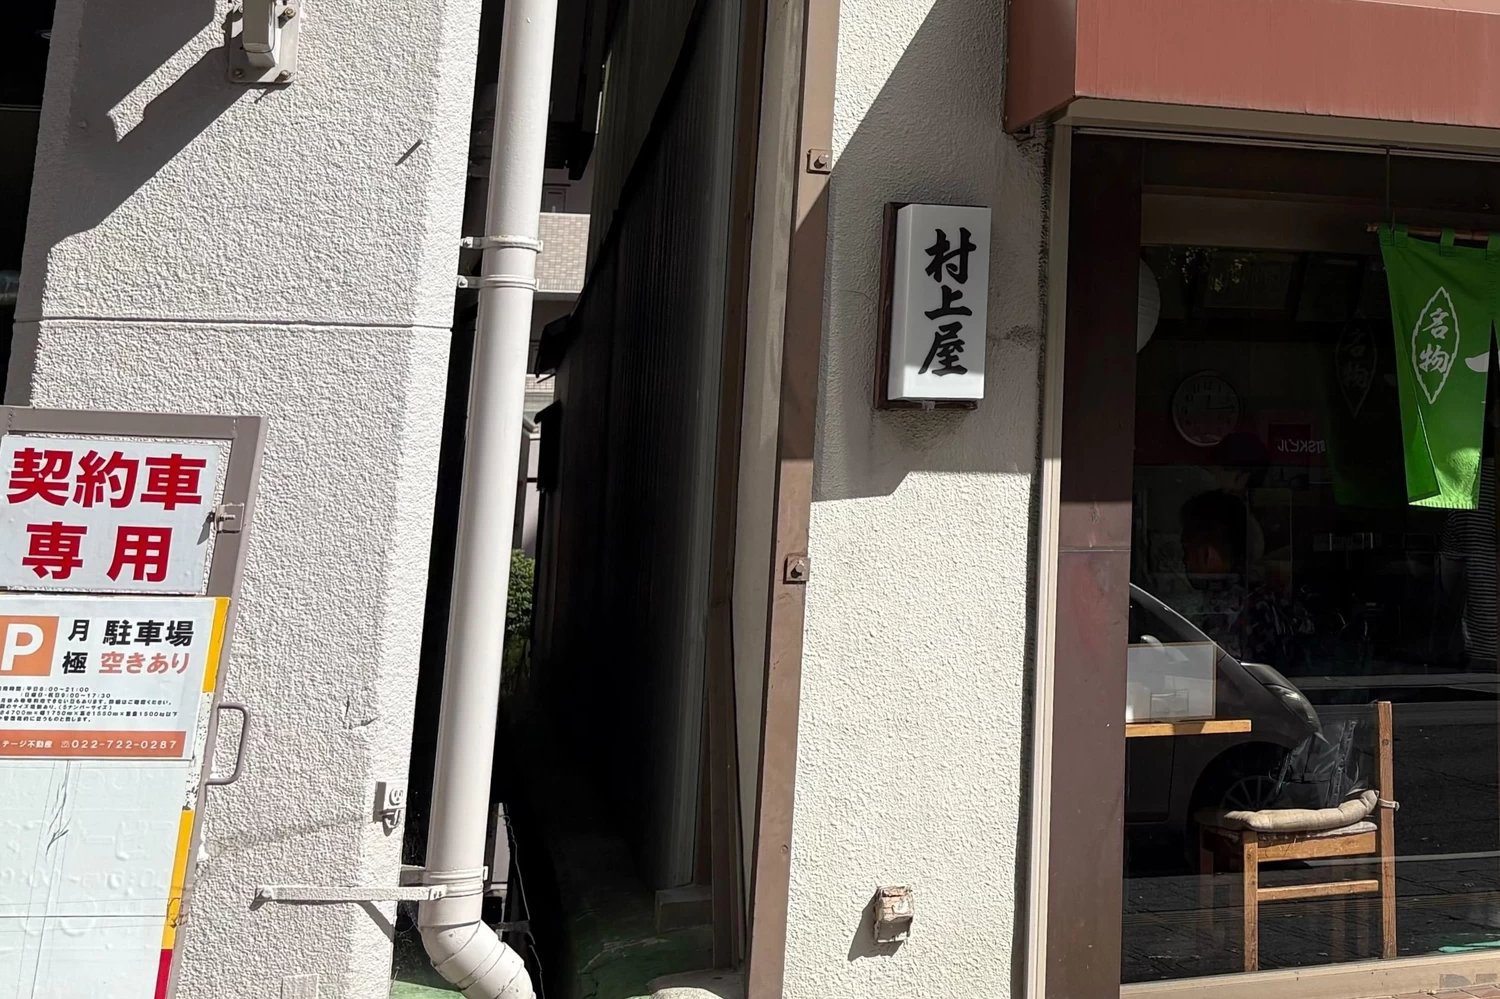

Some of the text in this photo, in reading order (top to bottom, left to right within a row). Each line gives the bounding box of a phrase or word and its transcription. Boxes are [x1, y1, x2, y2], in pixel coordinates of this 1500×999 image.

[917, 226, 978, 377] 村上屋
[1418, 307, 1450, 374] 名物
[6, 447, 207, 511] 契約車
[22, 521, 173, 582] 専用
[0, 623, 44, 671] P
[102, 619, 194, 647] 駐車場
[98, 651, 190, 675] 空きあり
[71, 740, 177, 750] 022-722-0287
